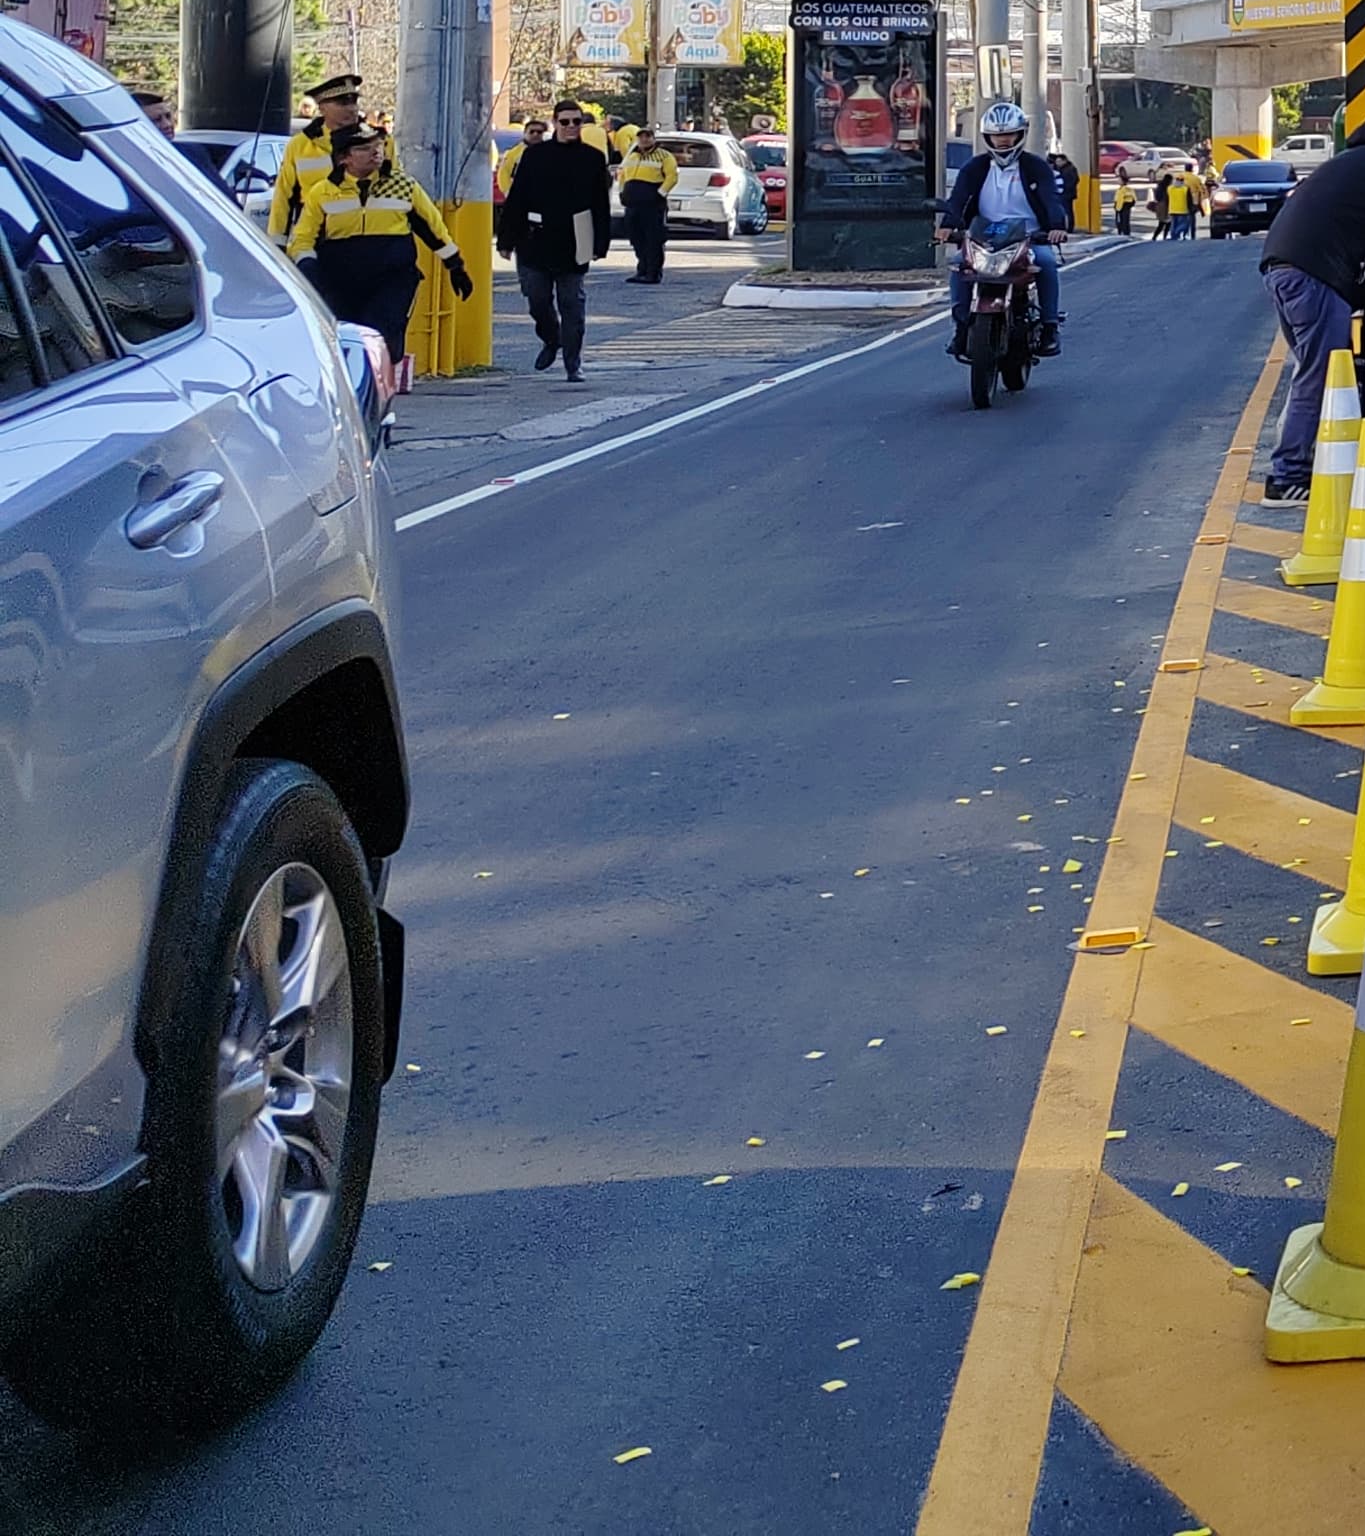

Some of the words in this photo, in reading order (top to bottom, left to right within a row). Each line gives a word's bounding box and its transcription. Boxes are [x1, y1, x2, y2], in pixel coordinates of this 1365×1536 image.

[795, 3, 820, 14] LOS
[822, 2, 929, 16] GUATEMALTECOS
[793, 16, 823, 27] CON
[825, 16, 849, 27] LOS
[852, 16, 879, 28] QUE
[882, 16, 929, 28] BRINDA
[823, 31, 838, 41] EL
[841, 31, 890, 42] MUNDO
